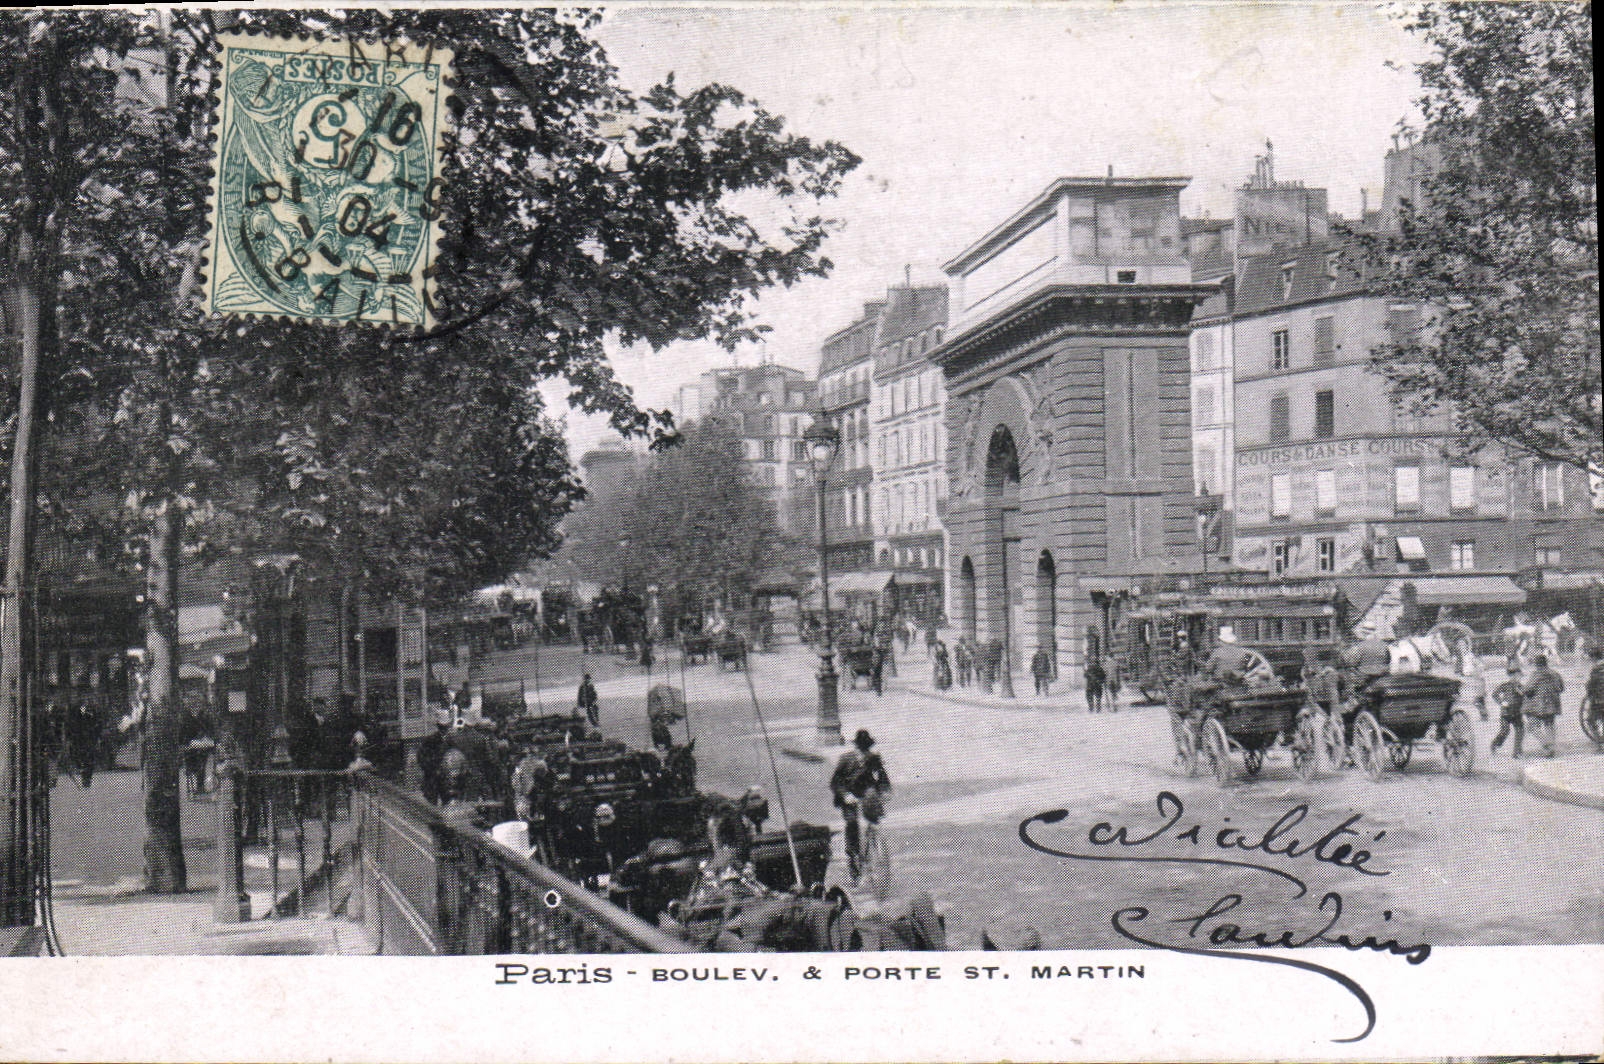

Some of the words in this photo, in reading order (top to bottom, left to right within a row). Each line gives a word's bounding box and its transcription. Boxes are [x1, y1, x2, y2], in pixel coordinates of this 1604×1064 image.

[287, 57, 382, 86] POSTES
[1237, 449, 1291, 467] COURS
[1305, 441, 1360, 461] DANSE
